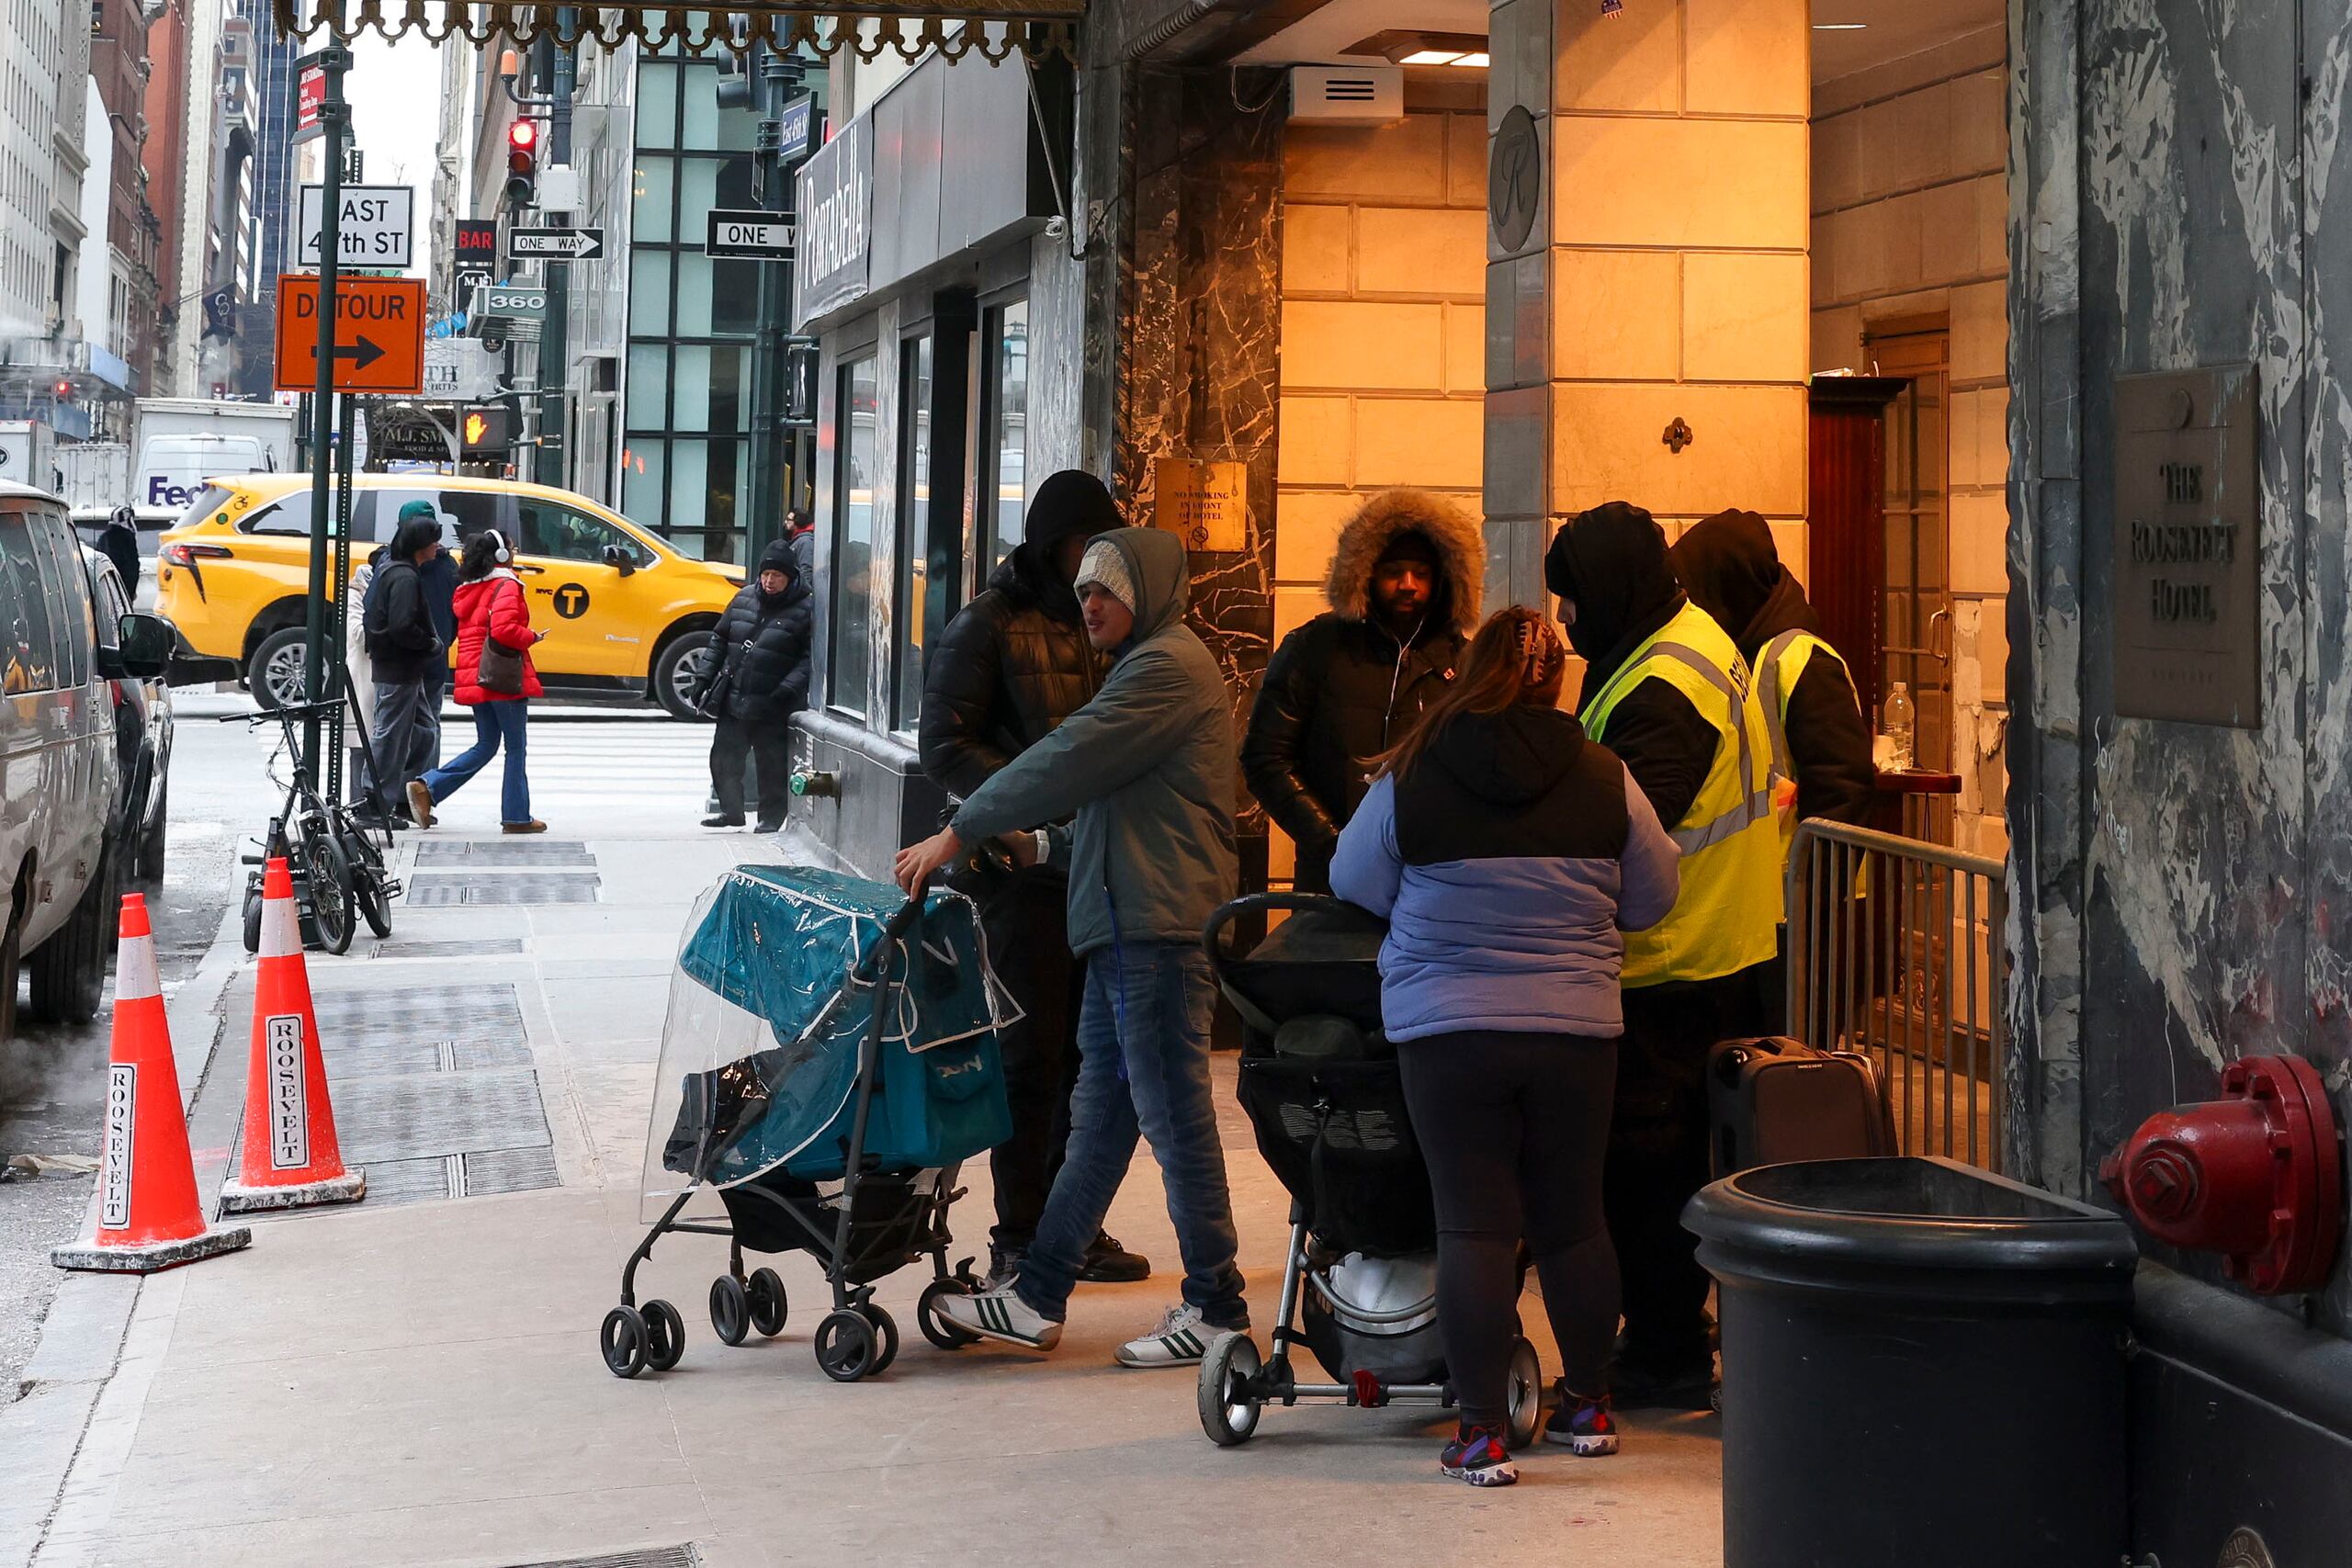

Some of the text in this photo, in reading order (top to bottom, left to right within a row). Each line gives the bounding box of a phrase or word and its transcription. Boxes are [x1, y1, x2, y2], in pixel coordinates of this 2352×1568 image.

[341, 199, 390, 222] AST
[308, 231, 404, 254] 4th ST
[458, 231, 493, 250] BAR
[519, 237, 586, 250] ONE WAY
[728, 225, 768, 244] ONE
[296, 293, 405, 321] DTOUR
[490, 295, 546, 310] 360
[148, 476, 210, 505] Fed
[276, 1023, 299, 1160] ROOSEVELT
[106, 1073, 126, 1217] ROOSEVELT
